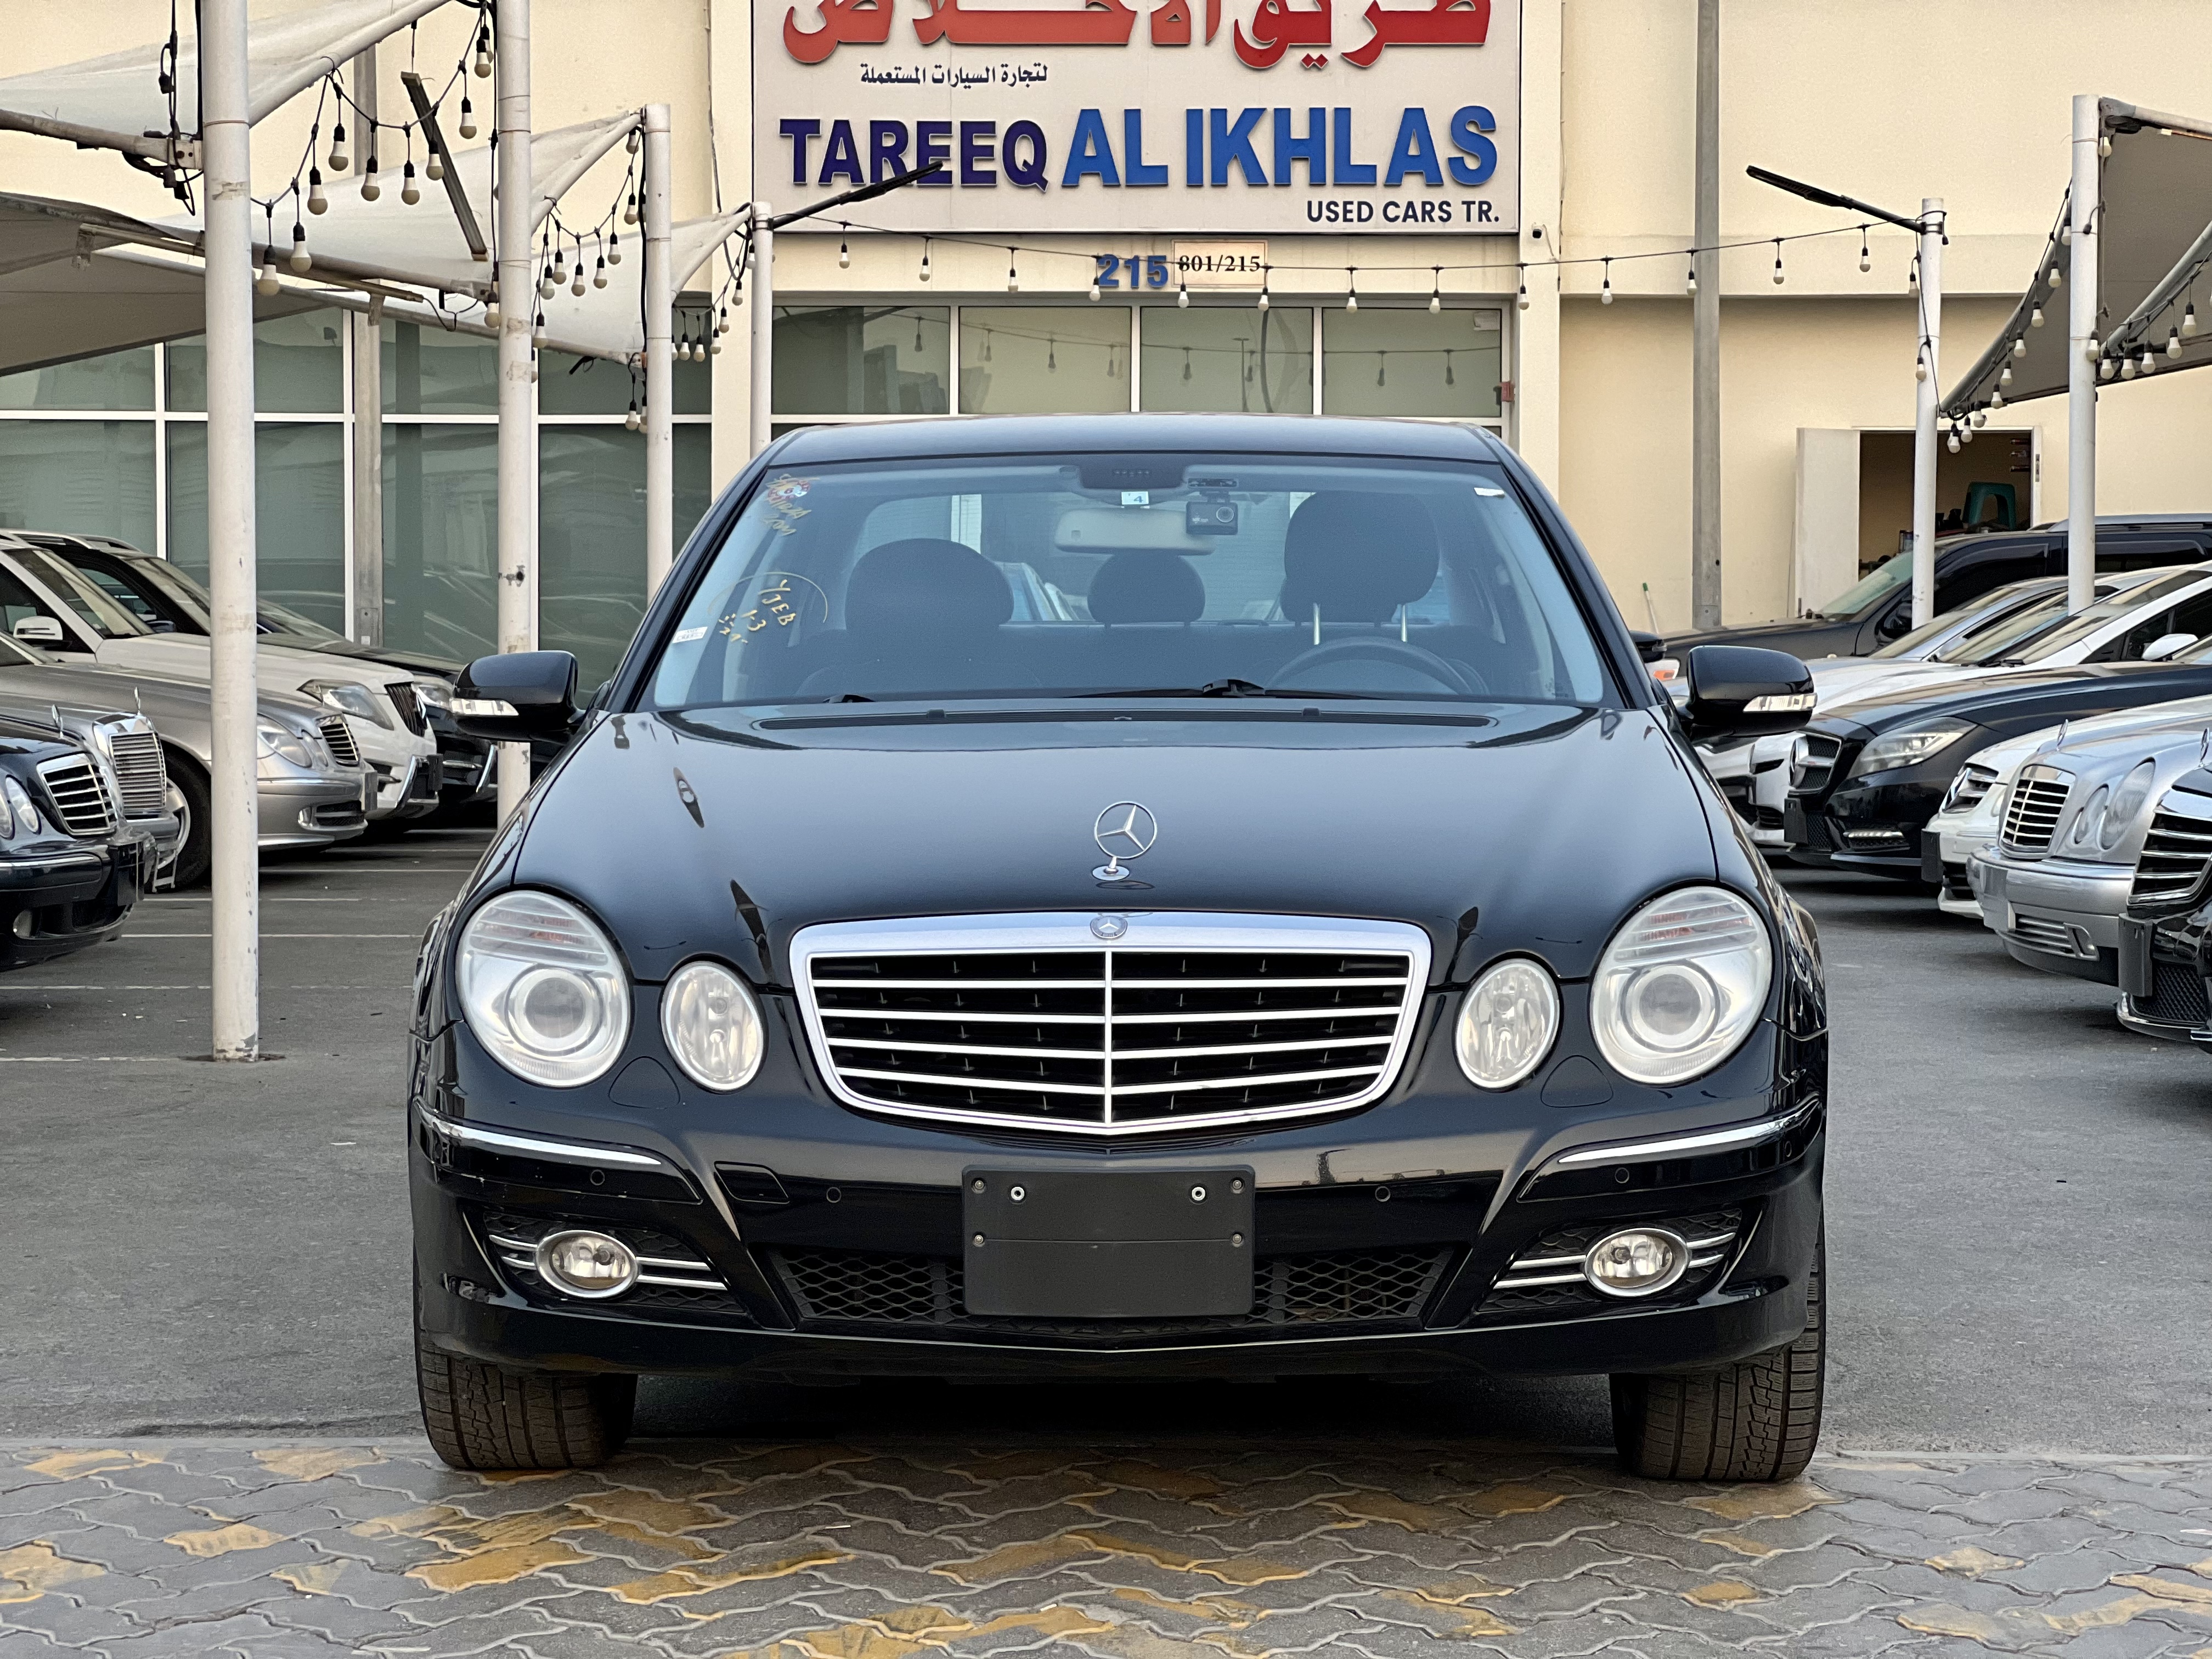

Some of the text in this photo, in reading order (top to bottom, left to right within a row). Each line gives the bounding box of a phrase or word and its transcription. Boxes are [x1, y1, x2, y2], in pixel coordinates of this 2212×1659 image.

[860, 62, 1048, 89] لتجارة السيارات المستعملة
[779, 105, 1498, 193] TAREEQ AL IKHLAS
[1307, 200, 1500, 223] USED CARS TR.
[1097, 254, 1169, 289] 215
[1178, 255, 1261, 273] 801/215
